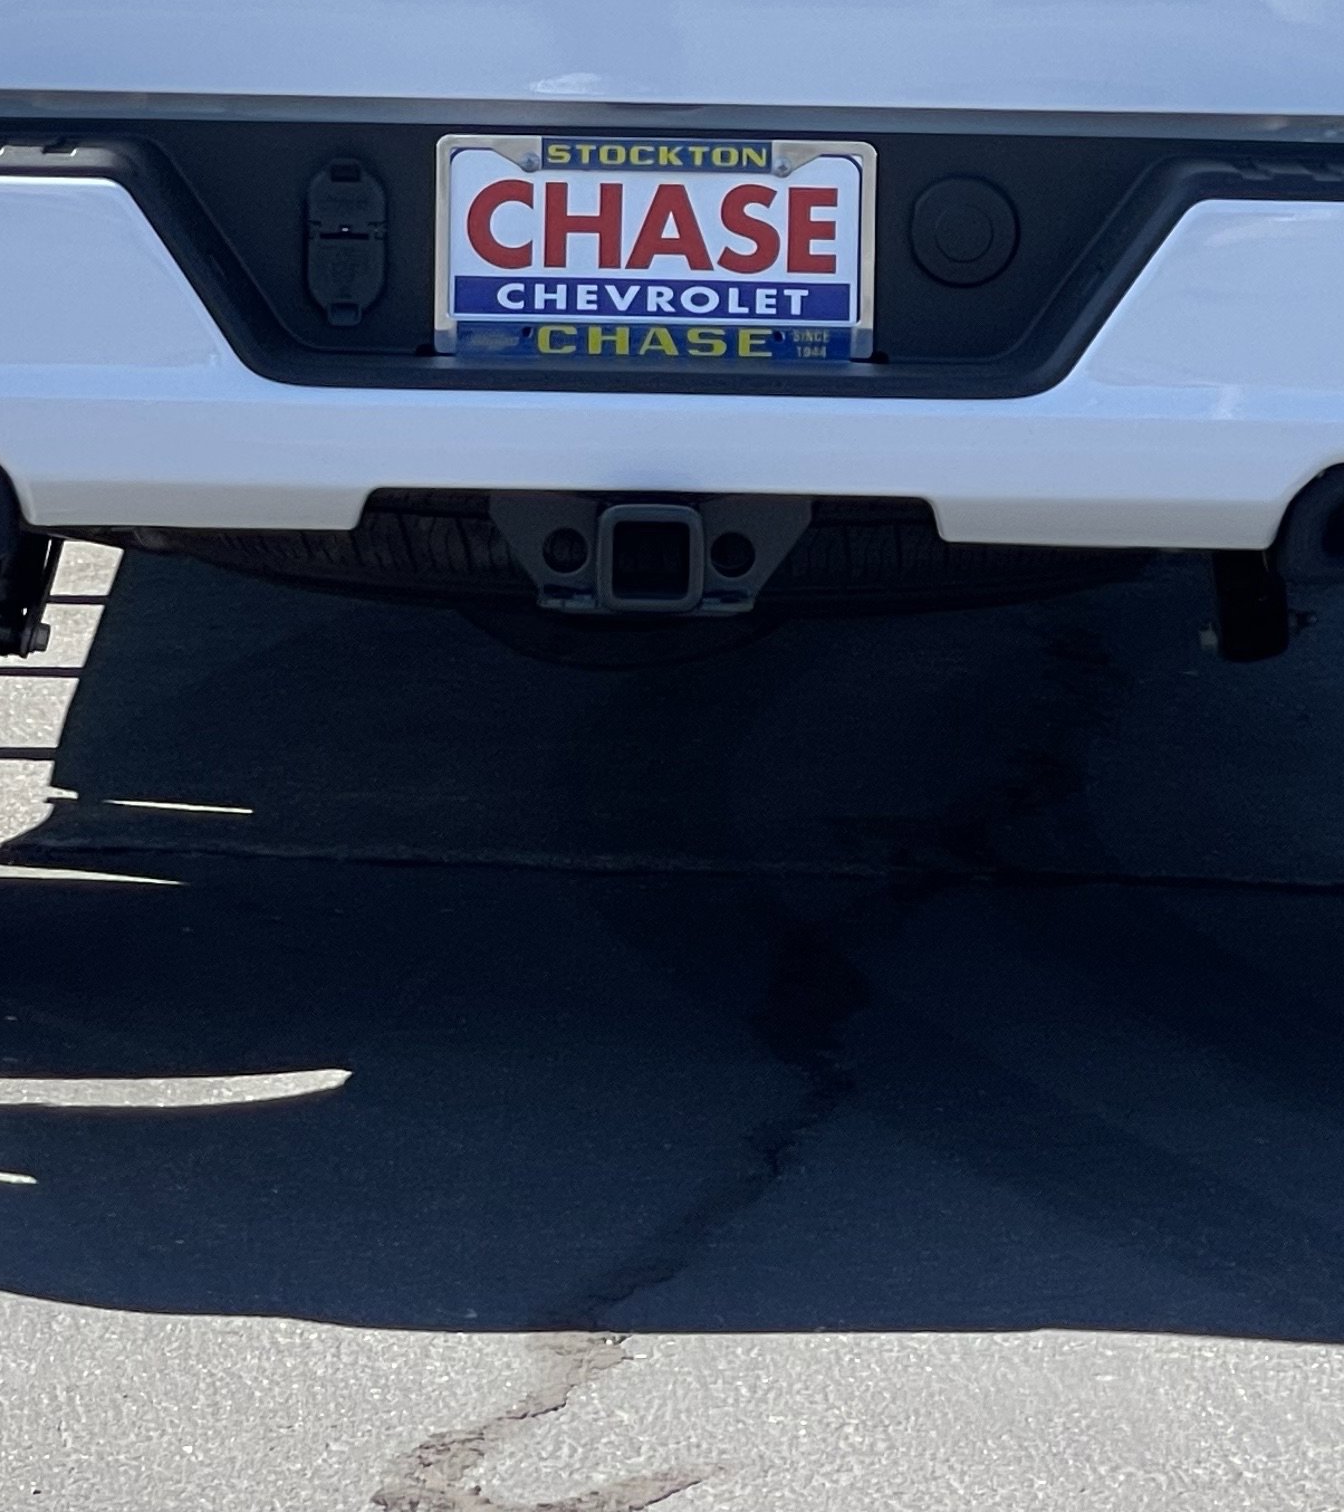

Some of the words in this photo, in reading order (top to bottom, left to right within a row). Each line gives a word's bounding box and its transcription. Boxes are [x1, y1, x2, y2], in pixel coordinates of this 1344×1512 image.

[546, 144, 767, 168] STOCKTON
[466, 179, 838, 274] CHASE
[496, 282, 809, 316] CHEVROLET
[537, 325, 773, 357] CHASE
